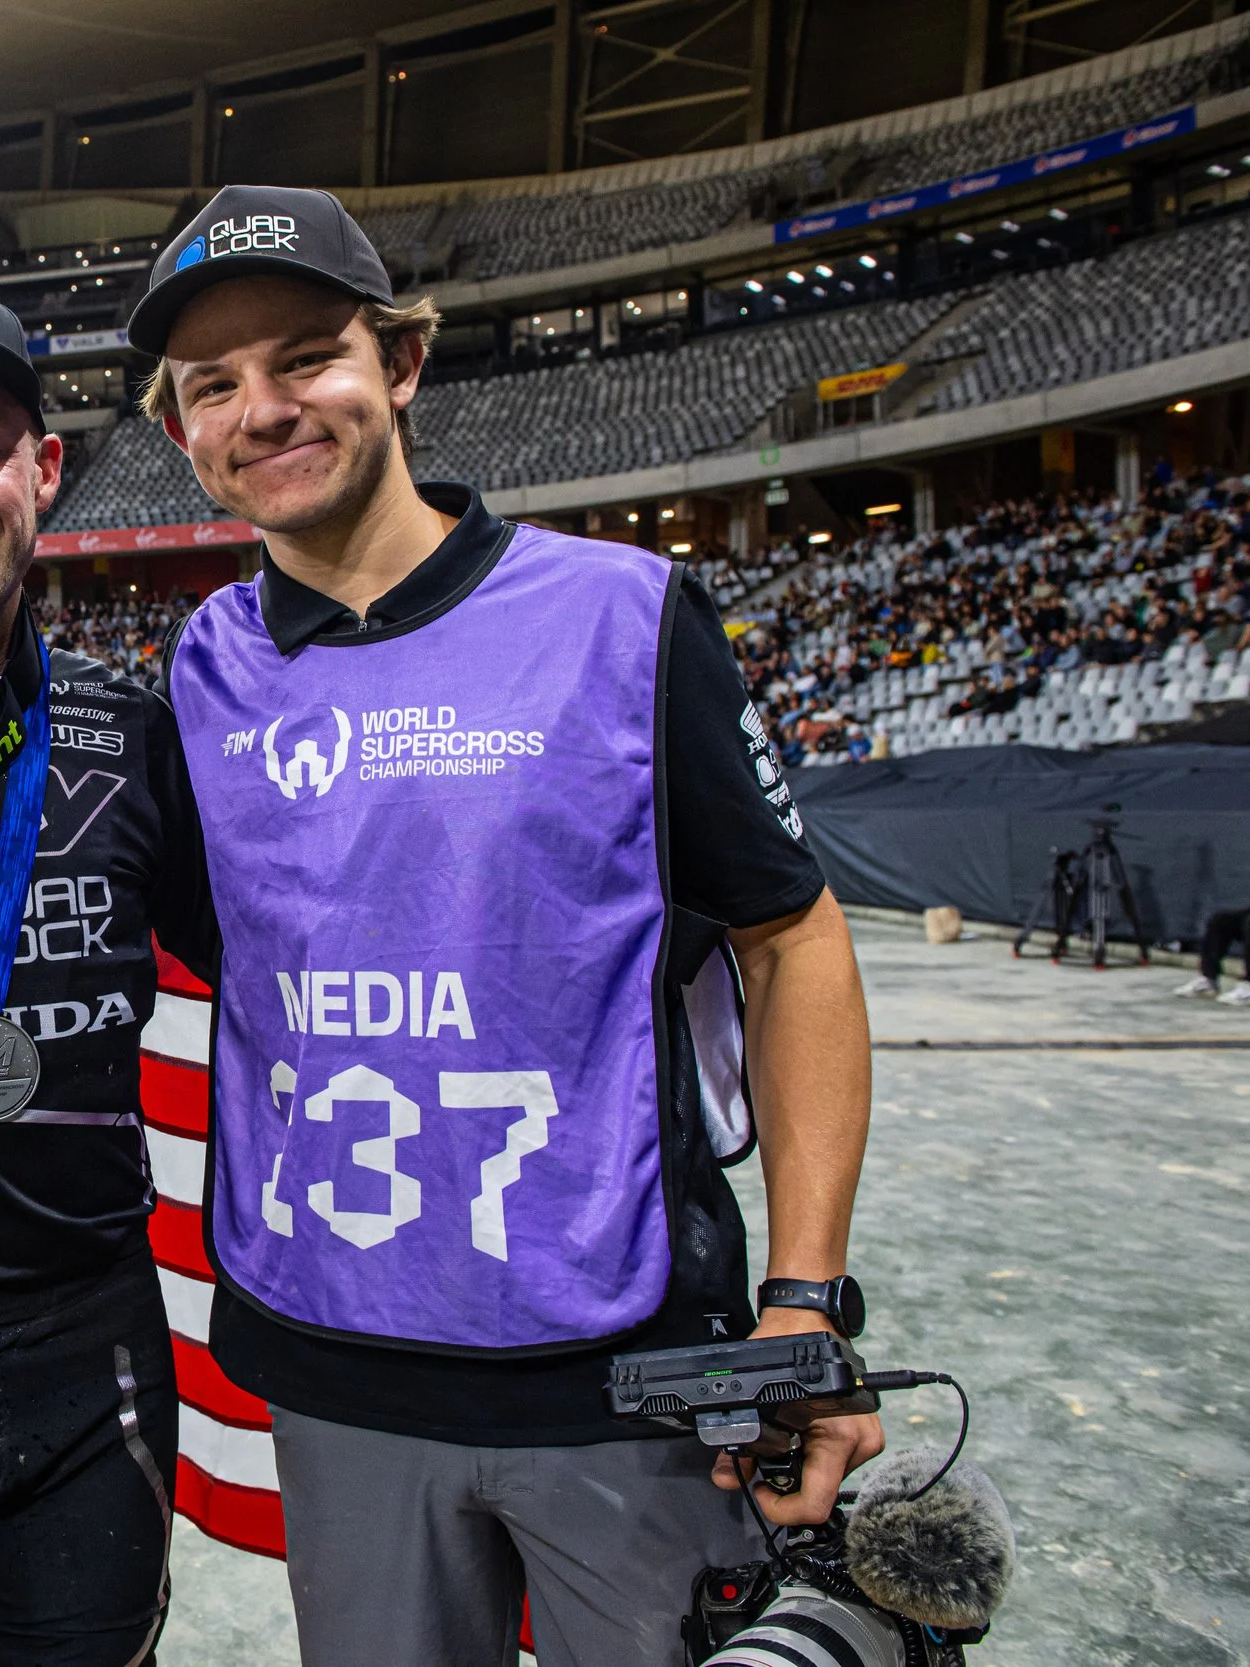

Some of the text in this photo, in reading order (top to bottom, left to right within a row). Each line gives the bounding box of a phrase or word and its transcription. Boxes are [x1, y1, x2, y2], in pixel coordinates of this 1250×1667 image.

[209, 215, 295, 241] QUAD
[210, 231, 297, 258] LOCK
[50, 705, 116, 723] ROGRESSIVE
[361, 705, 456, 735] WORLD
[221, 728, 257, 756] FIM
[360, 730, 546, 761] SUPERCROSS
[359, 757, 506, 781] CHAMPIONSHIP
